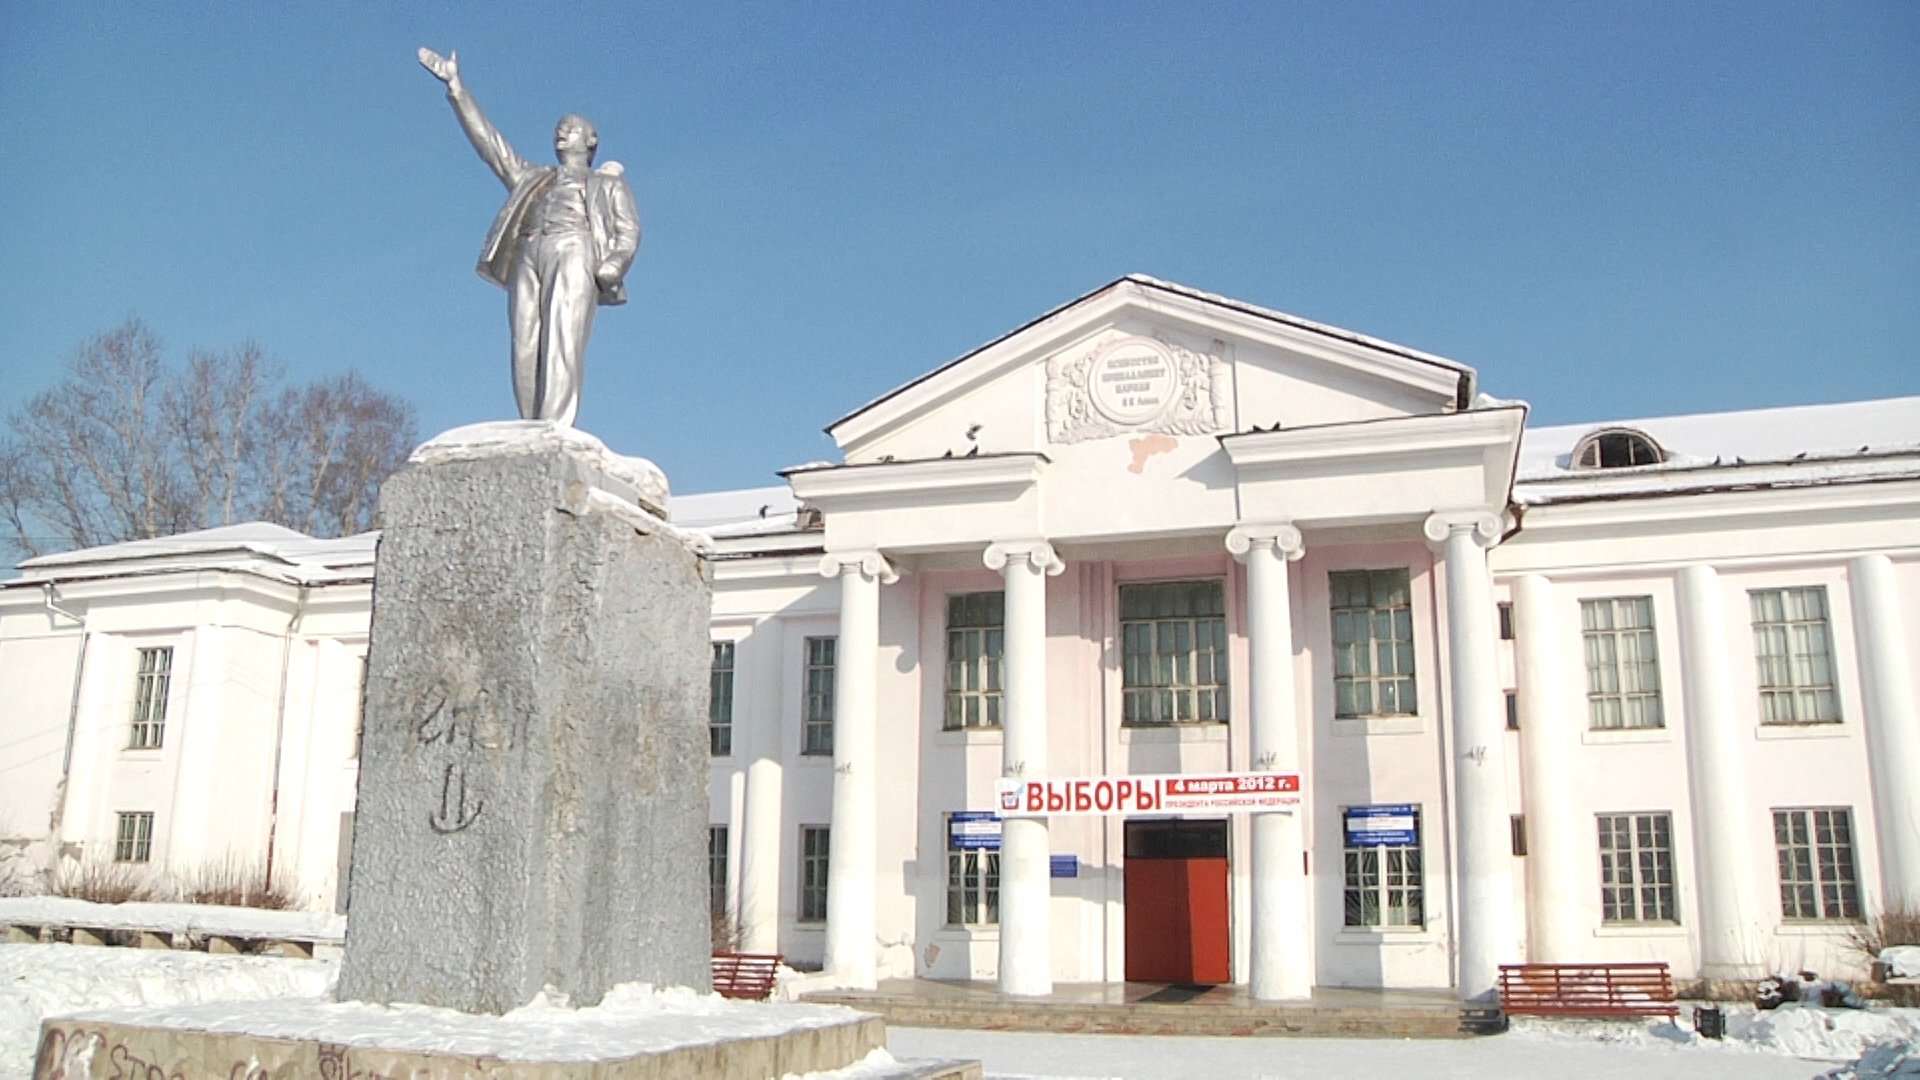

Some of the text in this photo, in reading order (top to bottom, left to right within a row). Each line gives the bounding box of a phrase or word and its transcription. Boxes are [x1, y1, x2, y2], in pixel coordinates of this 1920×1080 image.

[1027, 779, 1161, 812] ВЫБОРЫ
[1174, 780, 1185, 792] 4
[1187, 781, 1235, 794] марта
[1237, 777, 1275, 790] 2012
